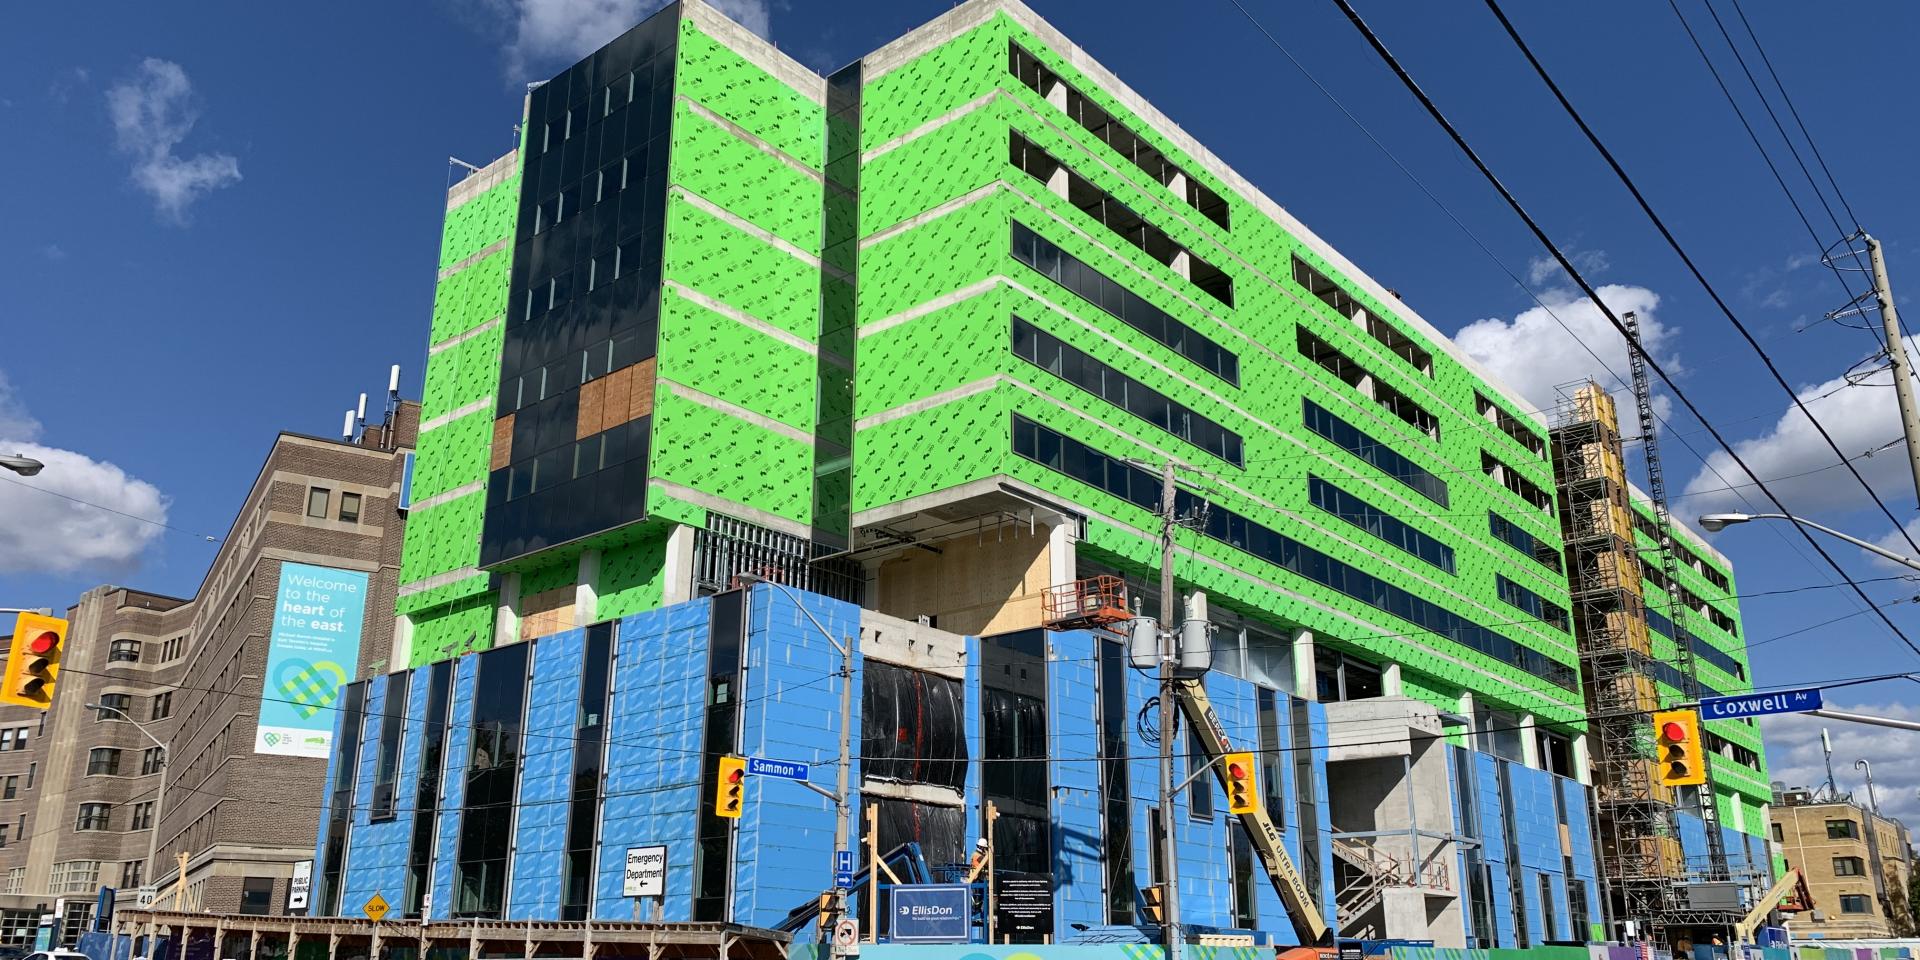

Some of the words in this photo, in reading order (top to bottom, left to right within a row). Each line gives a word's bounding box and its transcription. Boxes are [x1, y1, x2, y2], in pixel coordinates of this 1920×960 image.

[288, 574, 357, 593] Welcome
[285, 588, 301, 600] to
[306, 590, 330, 603] the
[282, 600, 325, 616] heart
[329, 607, 346, 618] of
[281, 615, 306, 628] the
[311, 620, 346, 633] east.
[1713, 694, 1789, 715] Coxwell
[1795, 692, 1808, 701] Av
[753, 760, 794, 776] Sammon
[627, 854, 663, 865] Emergency
[840, 852, 851, 870] H
[1262, 822, 1276, 842] JLG
[1276, 845, 1293, 877] ULTRA
[1292, 877, 1310, 907] BOOM
[294, 876, 308, 885] PUBLIC
[626, 869, 662, 880] Department
[291, 885, 309, 893] PARKING
[140, 895, 153, 905] 40
[912, 905, 952, 915] EllisDon
